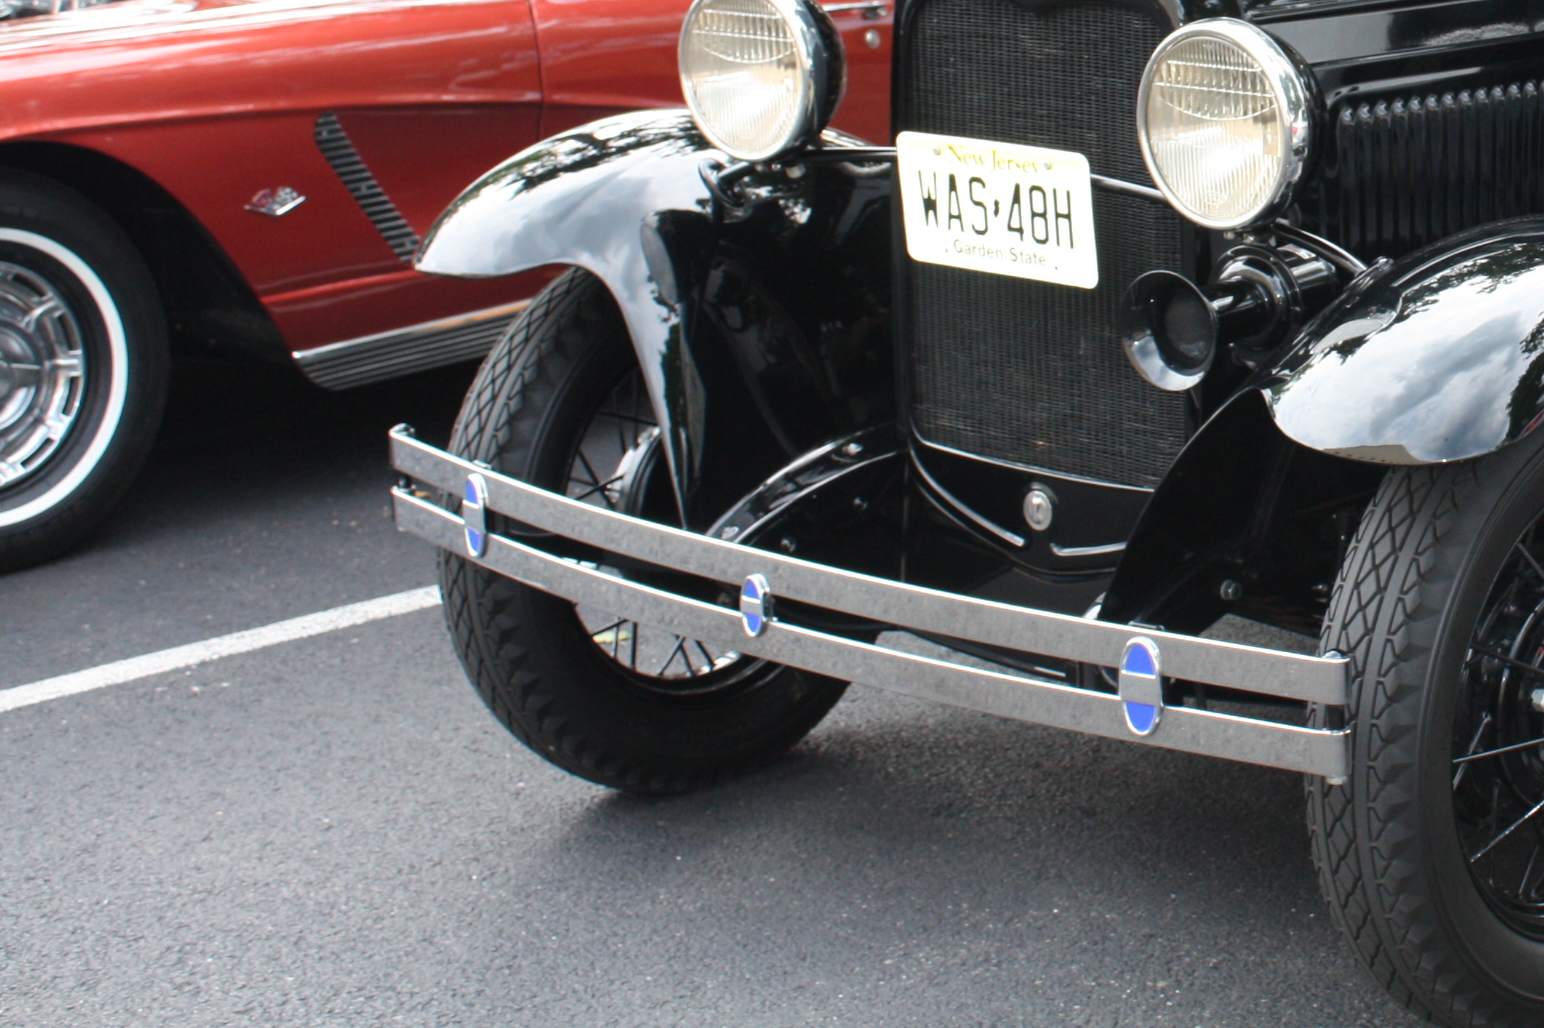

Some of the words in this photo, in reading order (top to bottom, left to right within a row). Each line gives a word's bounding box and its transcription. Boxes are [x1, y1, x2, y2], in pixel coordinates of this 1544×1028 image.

[946, 143, 985, 164] New
[991, 149, 1040, 173] Jersey
[952, 239, 1003, 259] Garden
[1009, 247, 1047, 266] State
